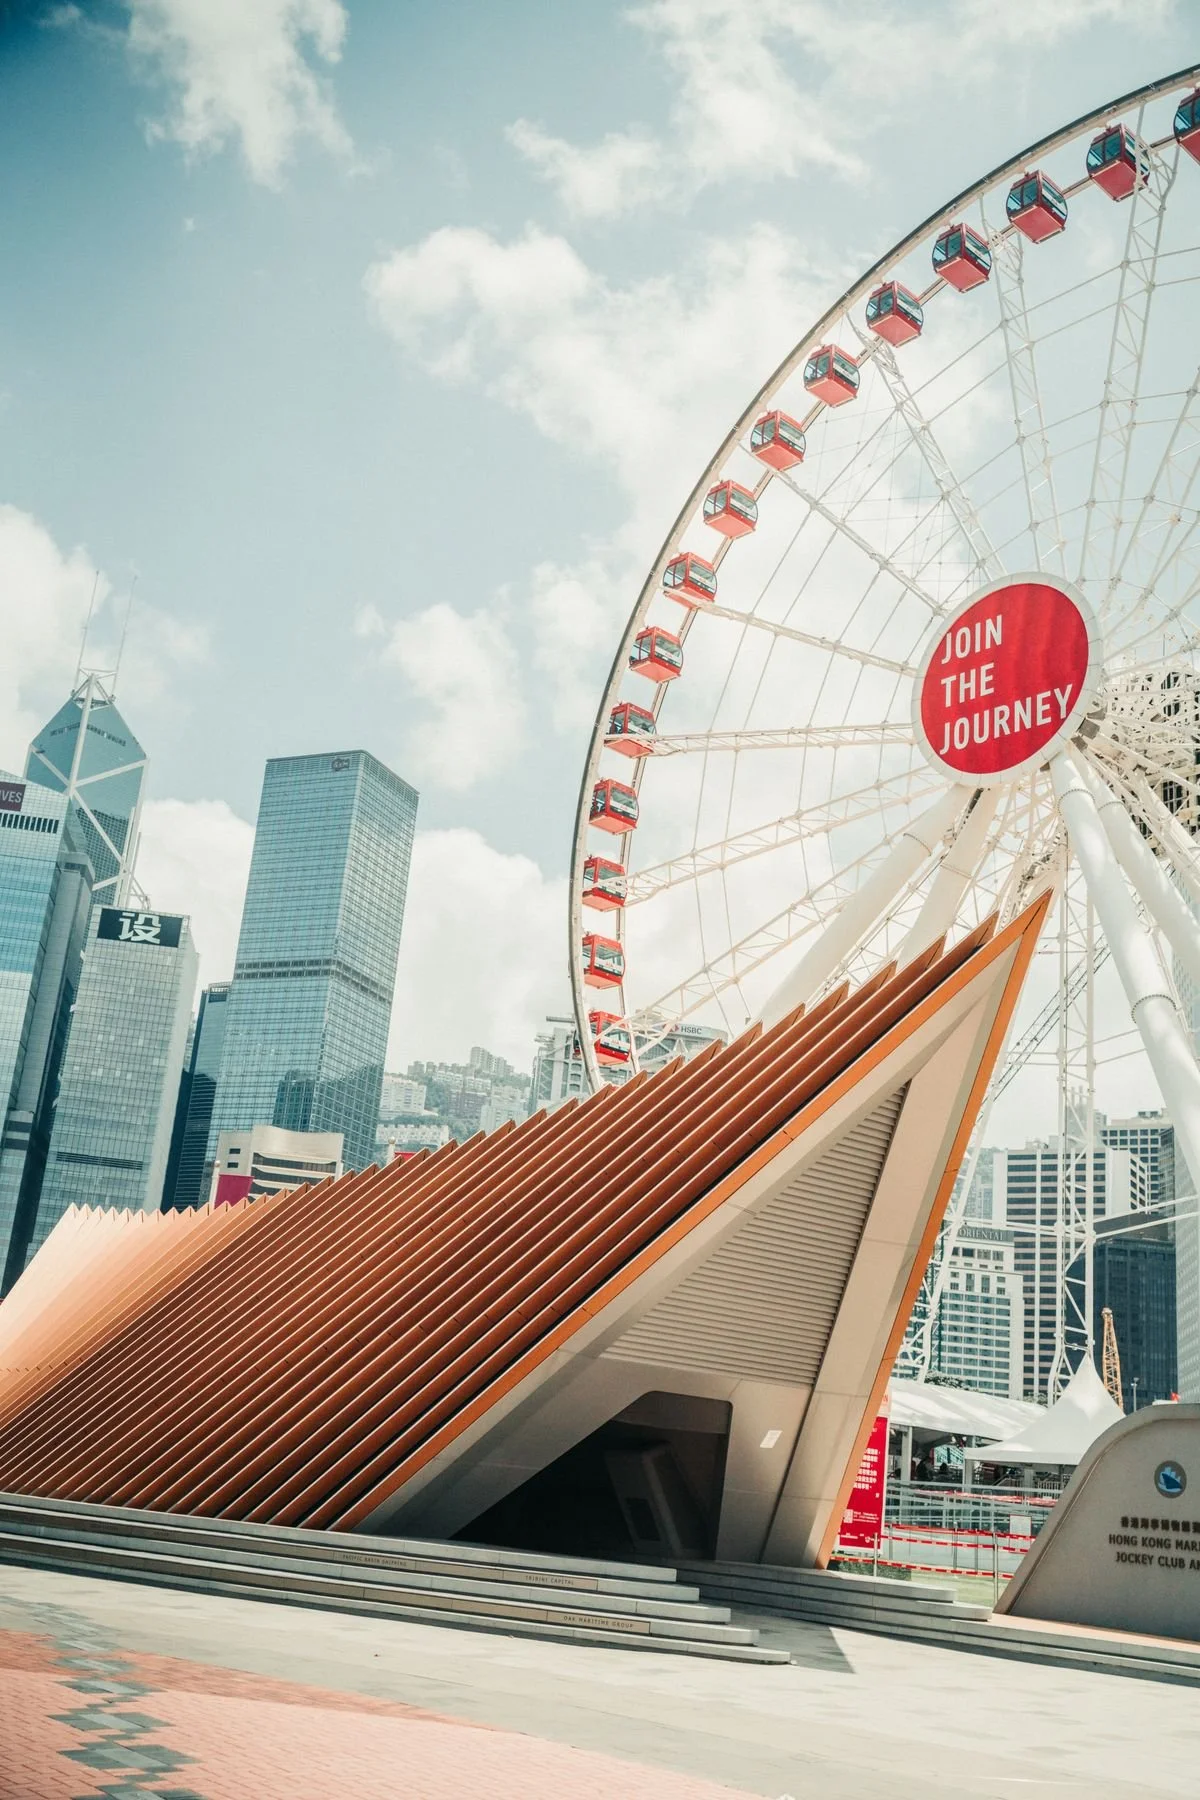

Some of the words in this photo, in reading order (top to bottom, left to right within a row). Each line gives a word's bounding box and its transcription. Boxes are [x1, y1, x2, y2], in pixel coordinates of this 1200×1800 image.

[941, 614, 1003, 665] JOIN
[940, 662, 995, 708] THE
[939, 683, 1073, 756] JOURNEY
[0, 790, 22, 803] VES
[118, 911, 162, 945] 设
[680, 1025, 702, 1035] HSBC
[1108, 1533, 1138, 1547] HONG
[1141, 1536, 1172, 1550] KONG
[1115, 1551, 1154, 1566] JOCKEY
[1157, 1555, 1186, 1569] CLUB
[550, 1578, 575, 1586] CAPITAL
[578, 1617, 609, 1626] MARITIME
[611, 1621, 634, 1629] GROUP
